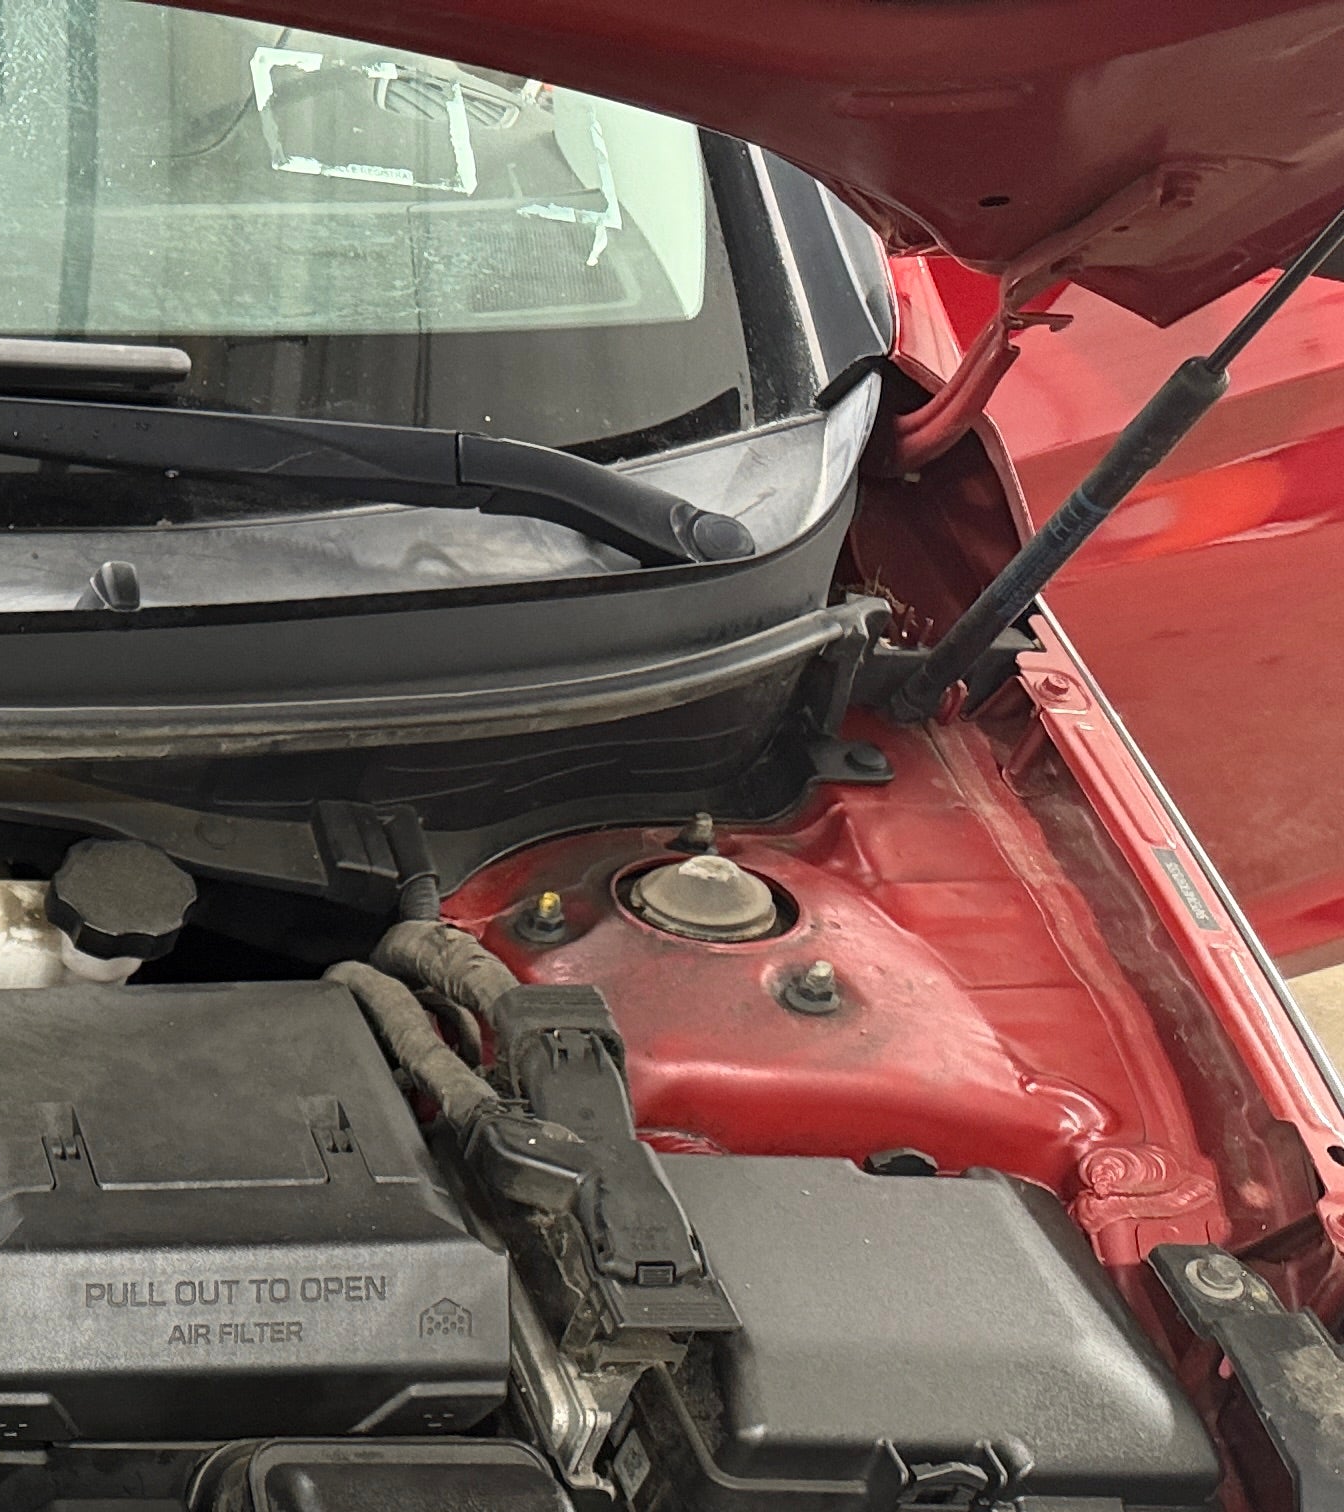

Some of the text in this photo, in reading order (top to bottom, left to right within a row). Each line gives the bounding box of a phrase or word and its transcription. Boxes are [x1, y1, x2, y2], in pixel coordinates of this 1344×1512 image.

[85, 1275, 388, 1309] PULL OUT TO OPEN
[167, 1320, 304, 1346] AIR FILTER
